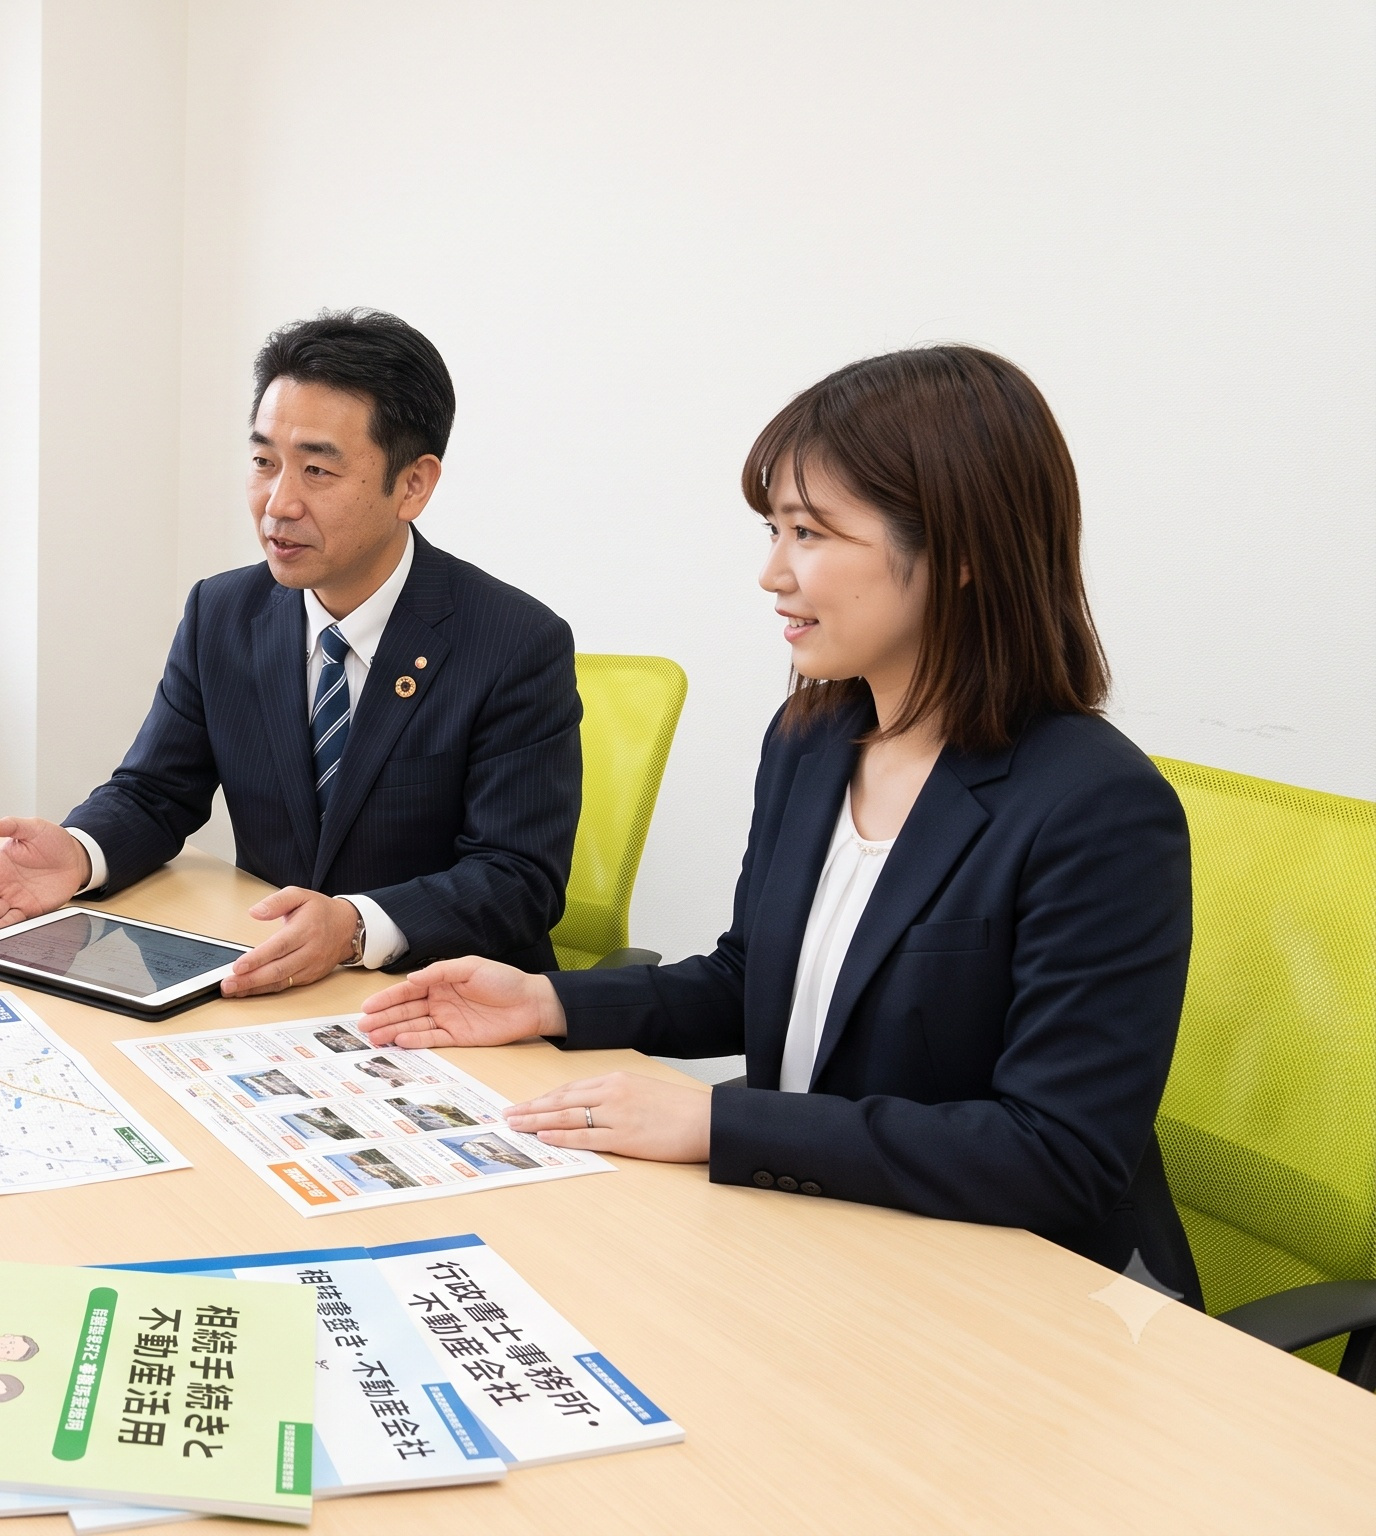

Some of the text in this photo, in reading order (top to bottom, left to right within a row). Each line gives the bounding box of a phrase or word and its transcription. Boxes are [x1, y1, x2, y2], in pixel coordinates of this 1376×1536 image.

[117, 1307, 182, 1446] 不動産活用
[182, 1305, 240, 1458] 相続手続きと
[408, 1292, 531, 1407] 不動産会社
